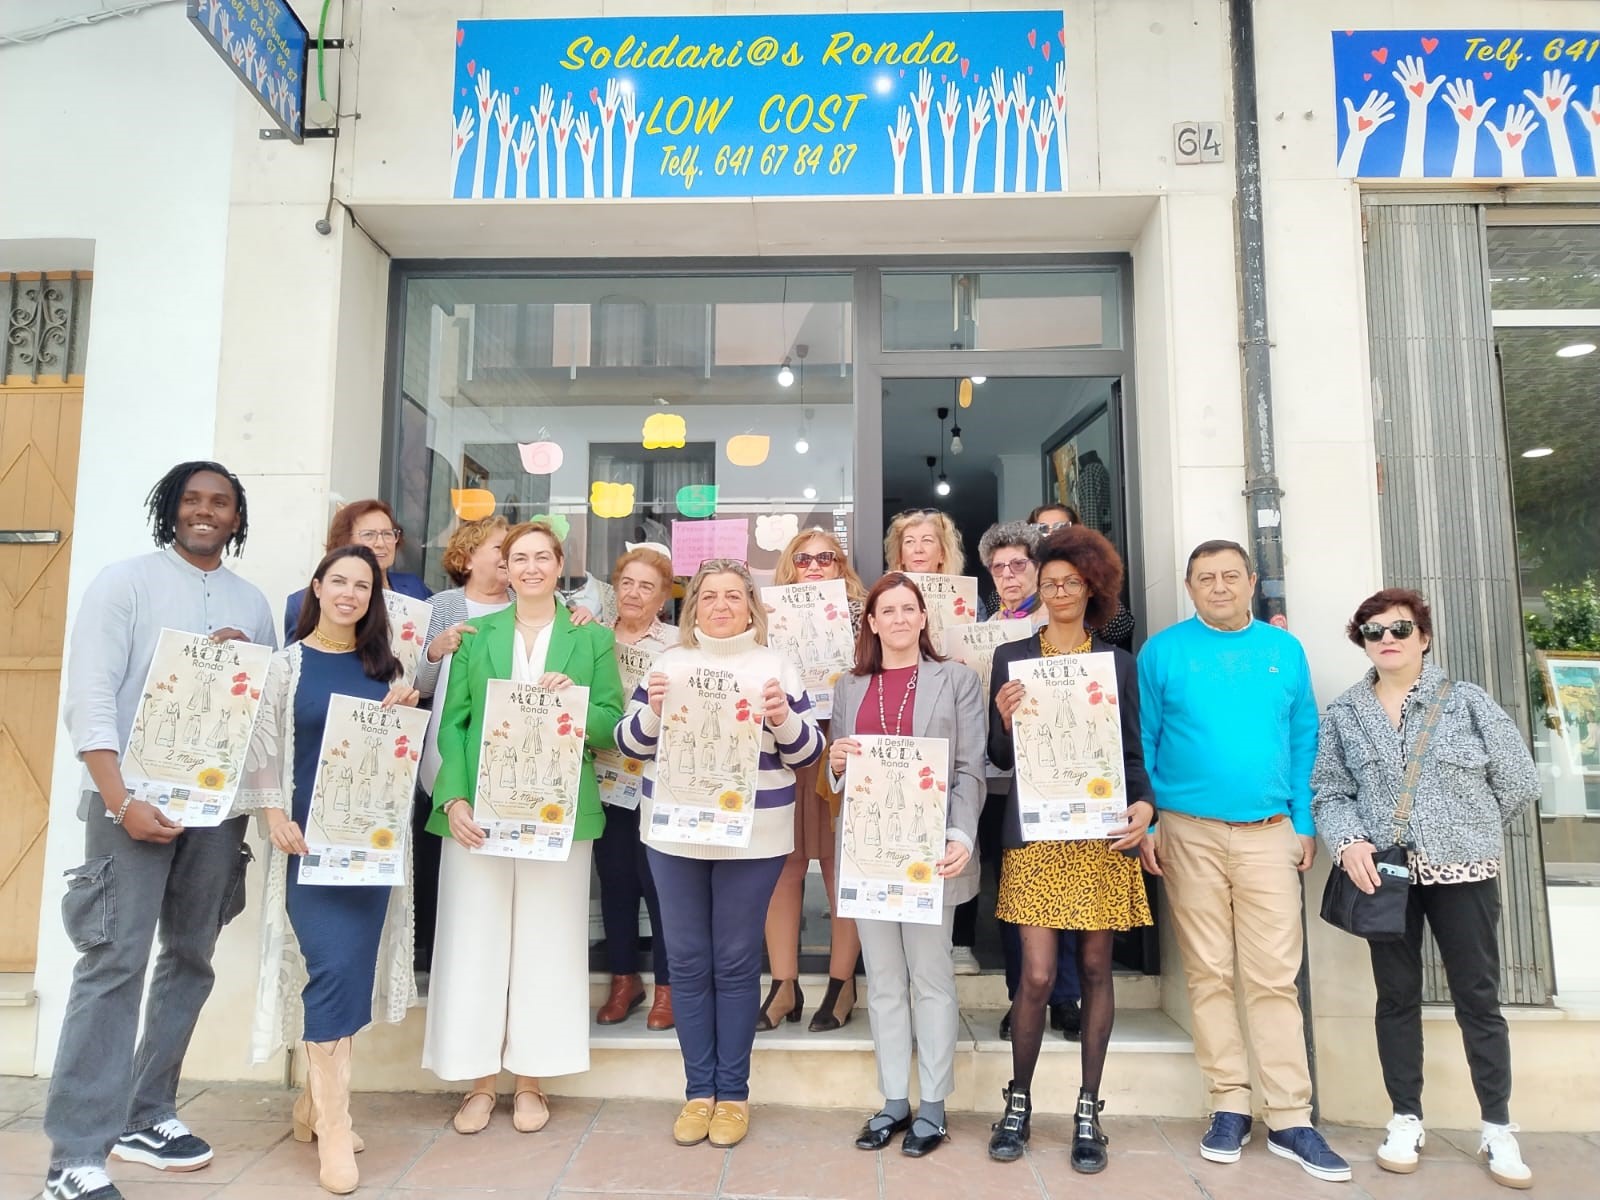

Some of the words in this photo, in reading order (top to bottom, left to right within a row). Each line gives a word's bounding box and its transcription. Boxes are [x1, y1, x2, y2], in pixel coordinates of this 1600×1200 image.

[559, 34, 804, 70] Solidari@s
[821, 30, 959, 66] Ronda
[1464, 37, 1532, 71] Telf.
[1543, 38, 1600, 62] 641
[645, 95, 734, 135] LOW
[759, 93, 868, 134] COST
[1176, 126, 1223, 157] 64
[660, 144, 703, 190] Telf.
[714, 144, 754, 176] 641
[759, 143, 789, 176] 67
[793, 143, 824, 176] 84
[828, 143, 858, 176] 87
[192, 658, 224, 671] Ronda
[1047, 658, 1078, 666] Desfile
[626, 666, 645, 677] Ronda
[703, 668, 734, 679] Desfile
[1045, 679, 1076, 687] Ronda
[698, 689, 727, 700] Ronda
[520, 704, 549, 715] Ronda
[361, 724, 389, 736] Ronda
[885, 738, 915, 748] Desfile
[165, 750, 174, 760] 2
[881, 759, 909, 769] Ronda
[1052, 768, 1059, 778] 2
[689, 776, 696, 787] 2
[510, 790, 517, 800] 2
[343, 813, 351, 825] 2
[875, 848, 882, 858] 2
